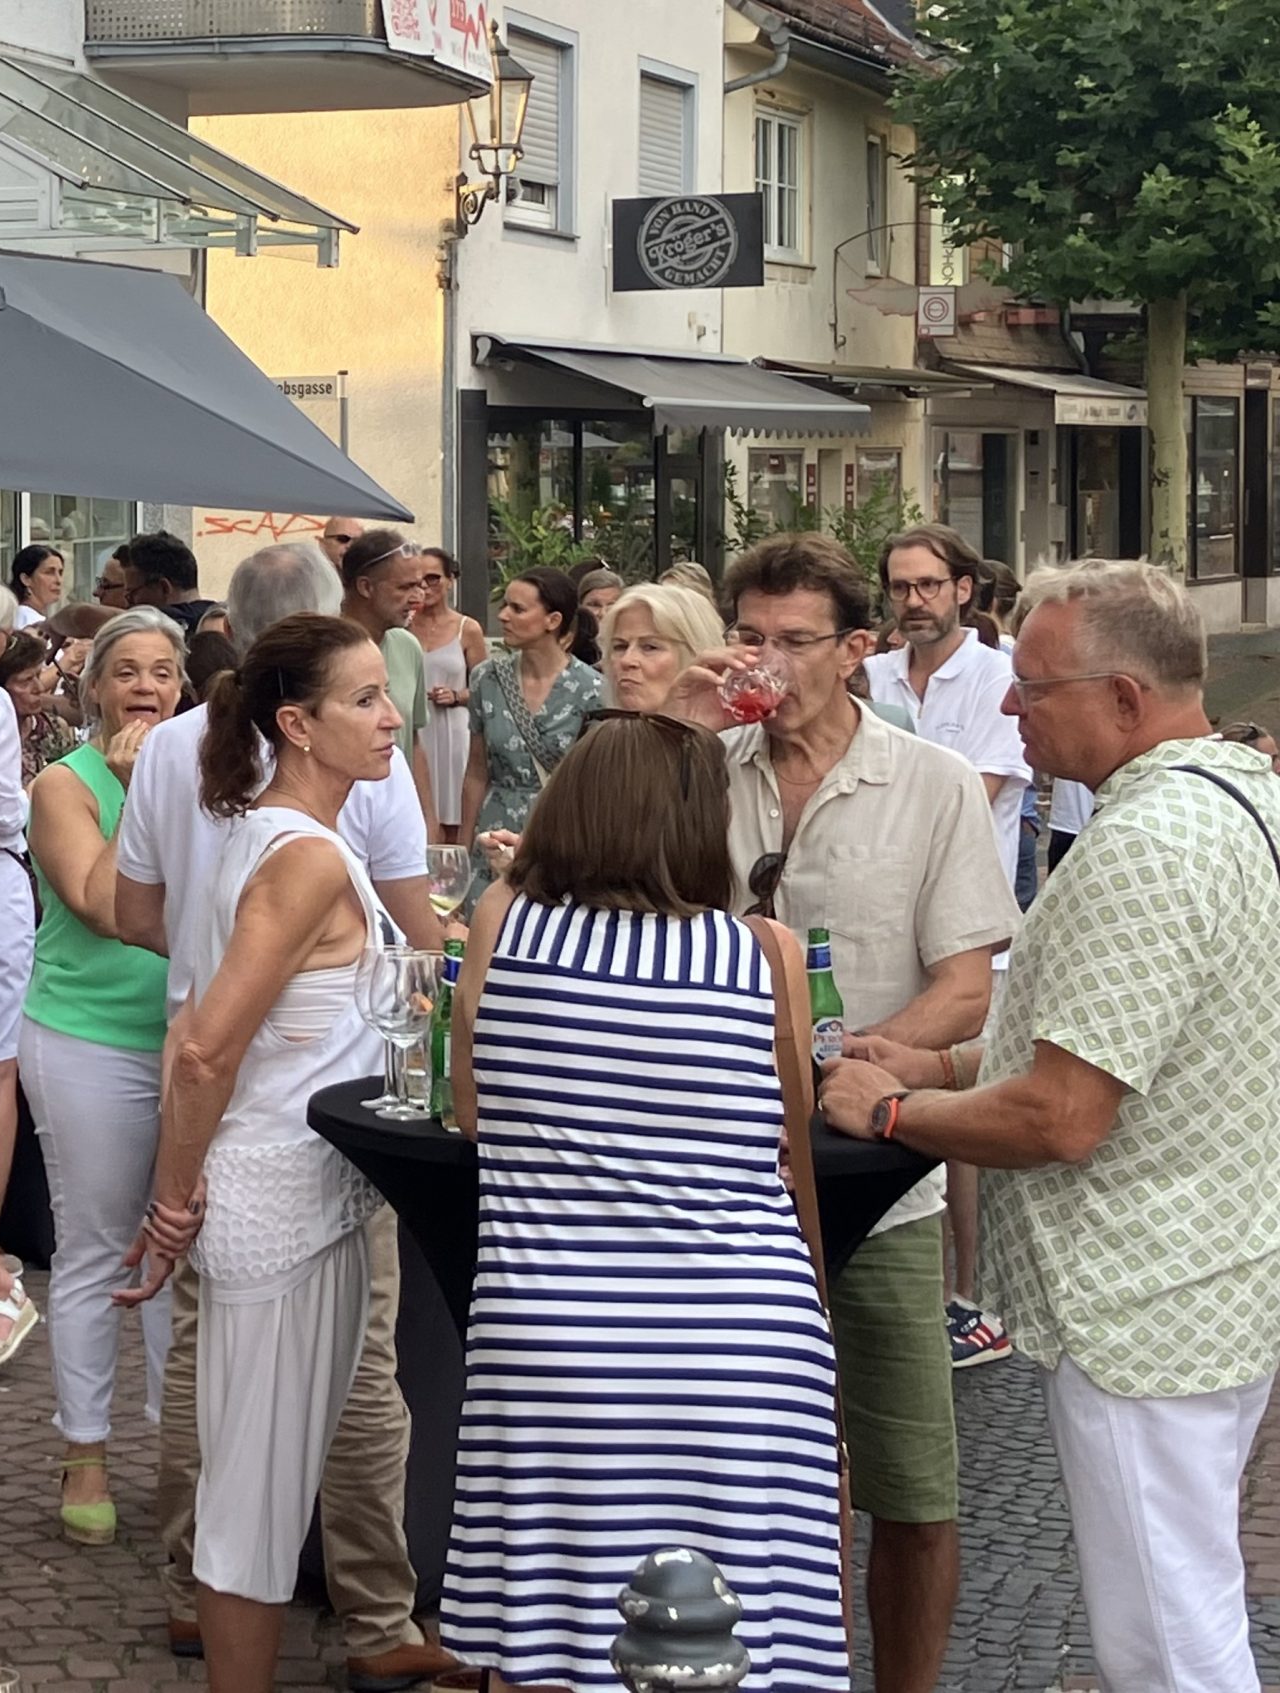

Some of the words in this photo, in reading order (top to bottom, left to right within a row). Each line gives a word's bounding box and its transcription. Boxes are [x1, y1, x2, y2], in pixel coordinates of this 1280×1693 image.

[648, 209, 672, 236] VON
[672, 201, 711, 217] HAND
[648, 221, 727, 267] Kröger's
[664, 249, 727, 284] GEMACHT
